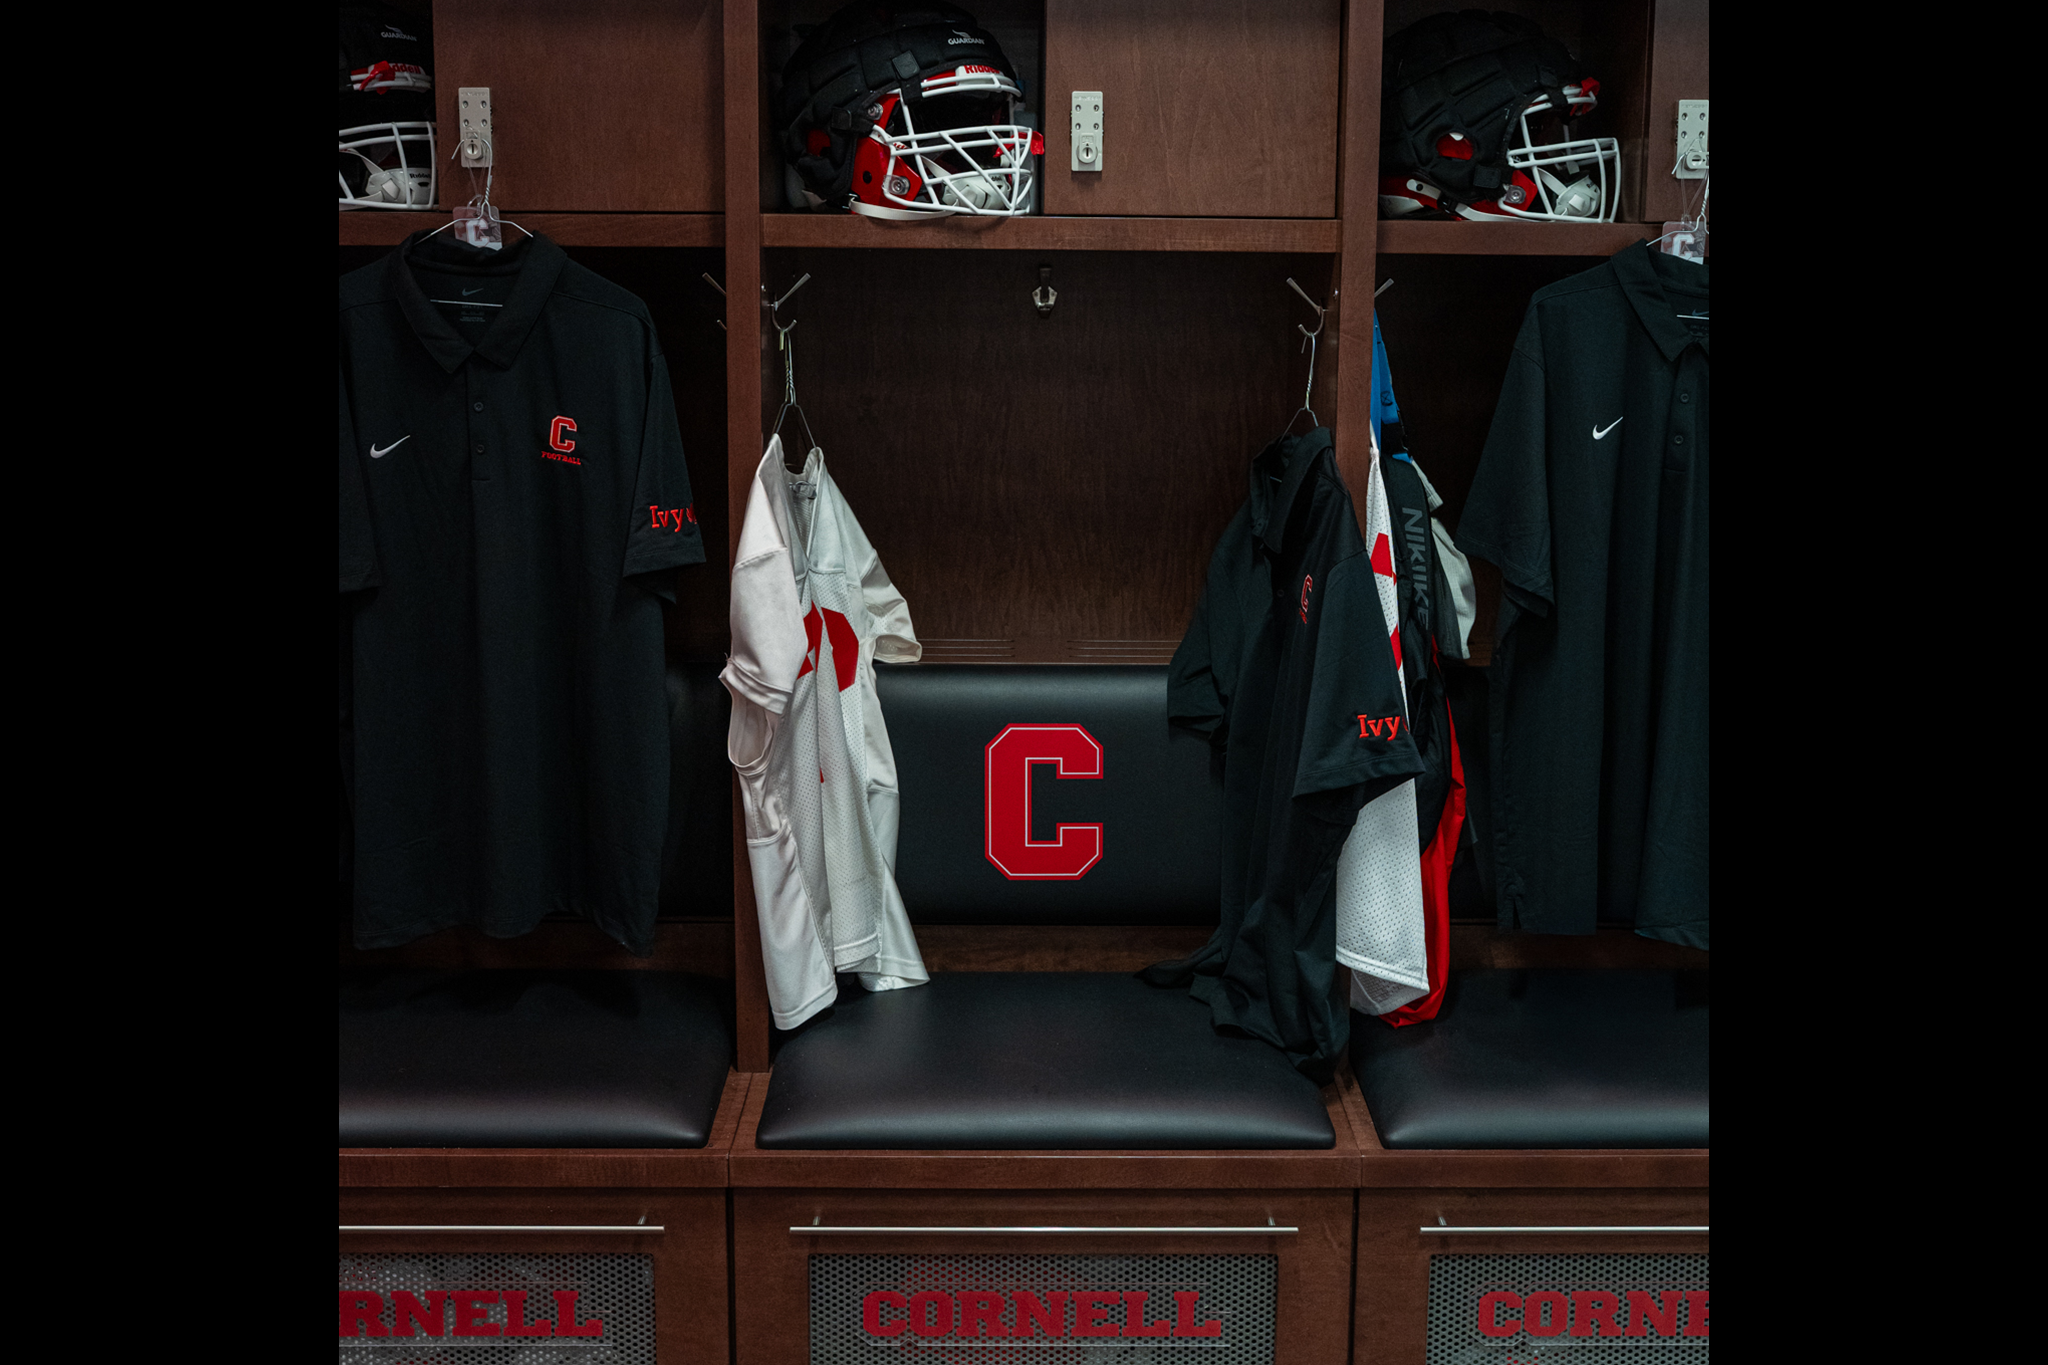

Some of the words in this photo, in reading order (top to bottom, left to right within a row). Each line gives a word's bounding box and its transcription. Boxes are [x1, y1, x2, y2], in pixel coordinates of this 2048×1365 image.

[947, 37, 985, 45] GUARDIAN
[549, 415, 577, 453] C
[541, 451, 581, 465] FOOTBALL
[649, 505, 685, 533] Ivy
[1357, 714, 1401, 742] Ivy
[984, 723, 1104, 881] C
[862, 1290, 1222, 1337] CORNELL
